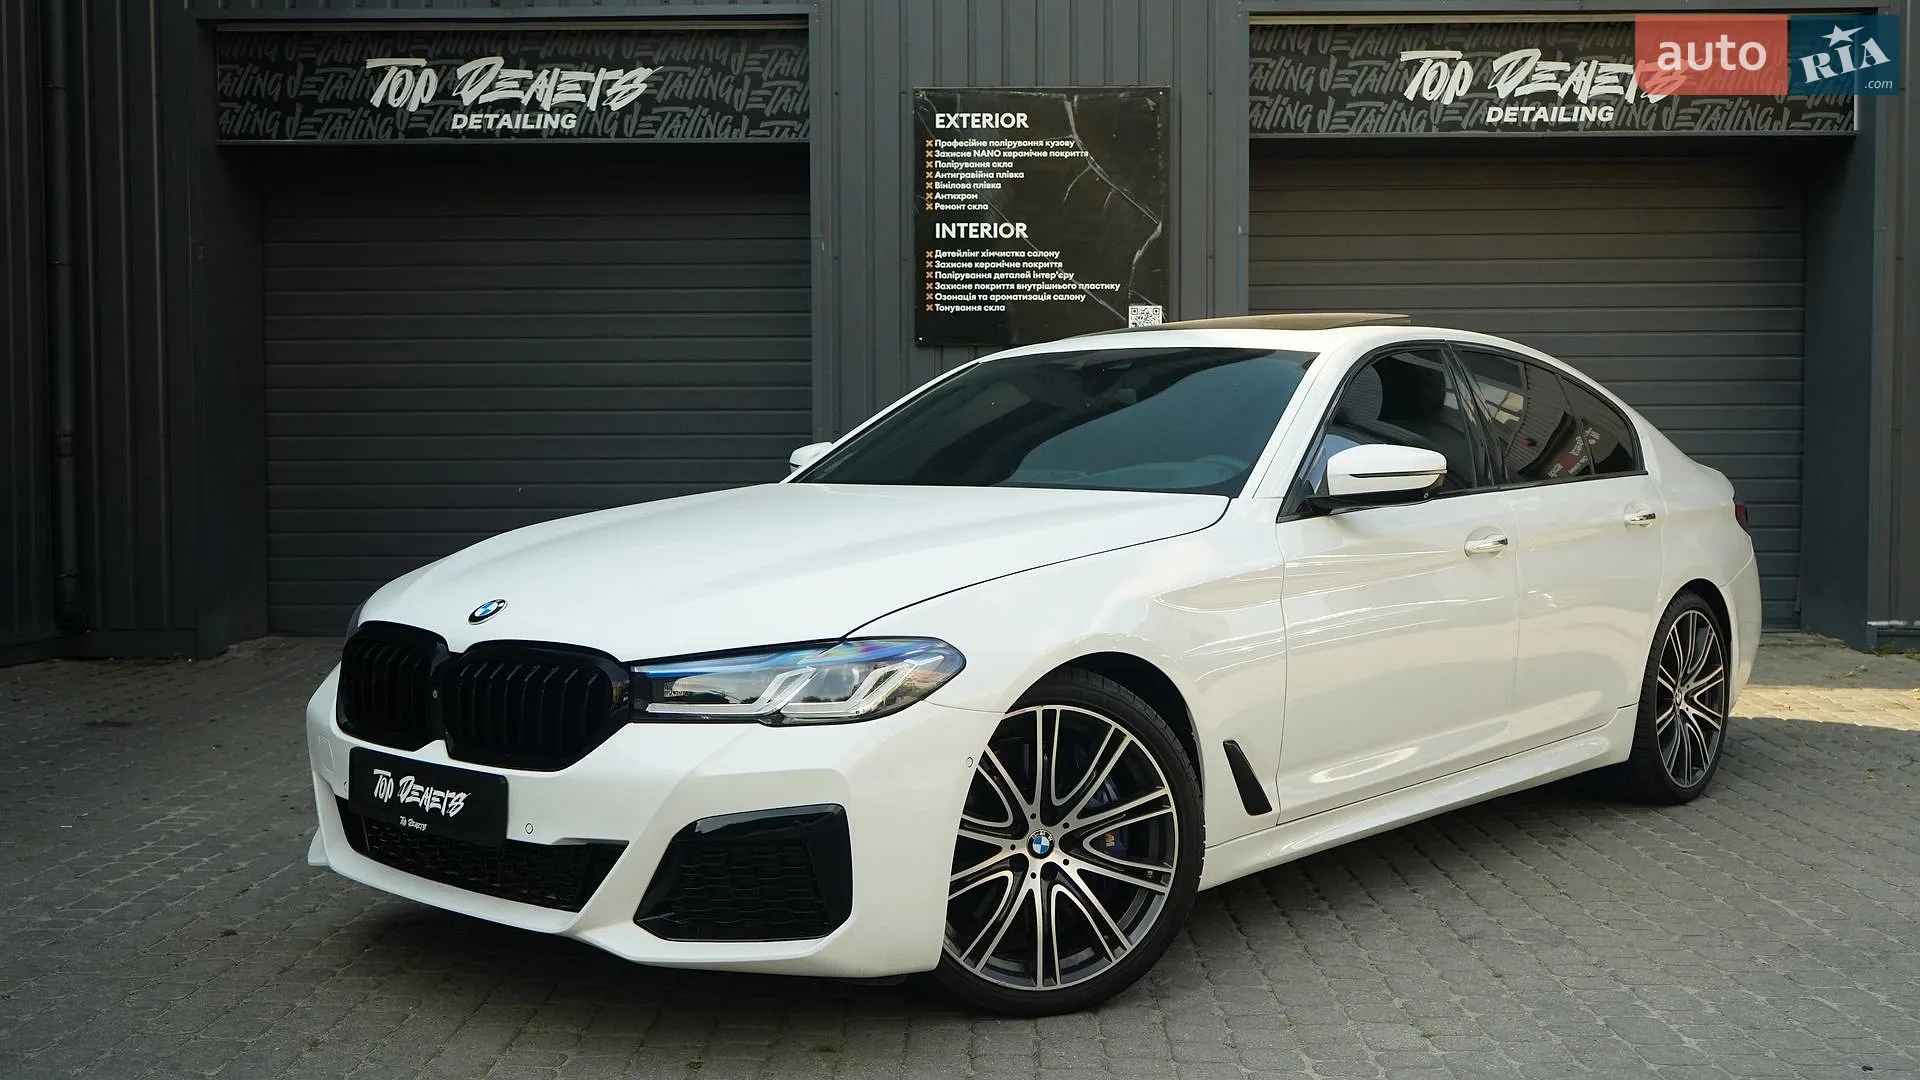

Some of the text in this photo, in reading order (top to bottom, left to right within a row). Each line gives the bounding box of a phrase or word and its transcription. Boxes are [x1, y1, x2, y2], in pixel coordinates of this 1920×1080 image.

[1486, 106, 1614, 123] DETAILING
[451, 113, 578, 130] DETAILING
[935, 113, 1029, 129] EXTERIOR
[935, 139, 1075, 149] Професійне полірування кузову
[935, 149, 1089, 159] Захисне NANO керамічне покриття
[935, 160, 990, 170] Полірування
[935, 170, 1024, 180] Антигравійна плівка
[935, 181, 1002, 189] Вінілова плівка
[935, 192, 978, 201] Антихром
[935, 222, 1028, 239] INTERIOR
[935, 249, 979, 258] Детейлінг
[981, 249, 1025, 258] хімчистка
[935, 260, 1062, 270] Захисне керамічне покриття
[935, 270, 992, 281] Полірування
[993, 271, 1031, 280] деталей
[935, 282, 1120, 291] Захисне покриття внутрішнього пластику
[935, 292, 976, 301] Озонація
[989, 293, 1052, 302] ароматизація
[935, 304, 982, 313] Тонування
